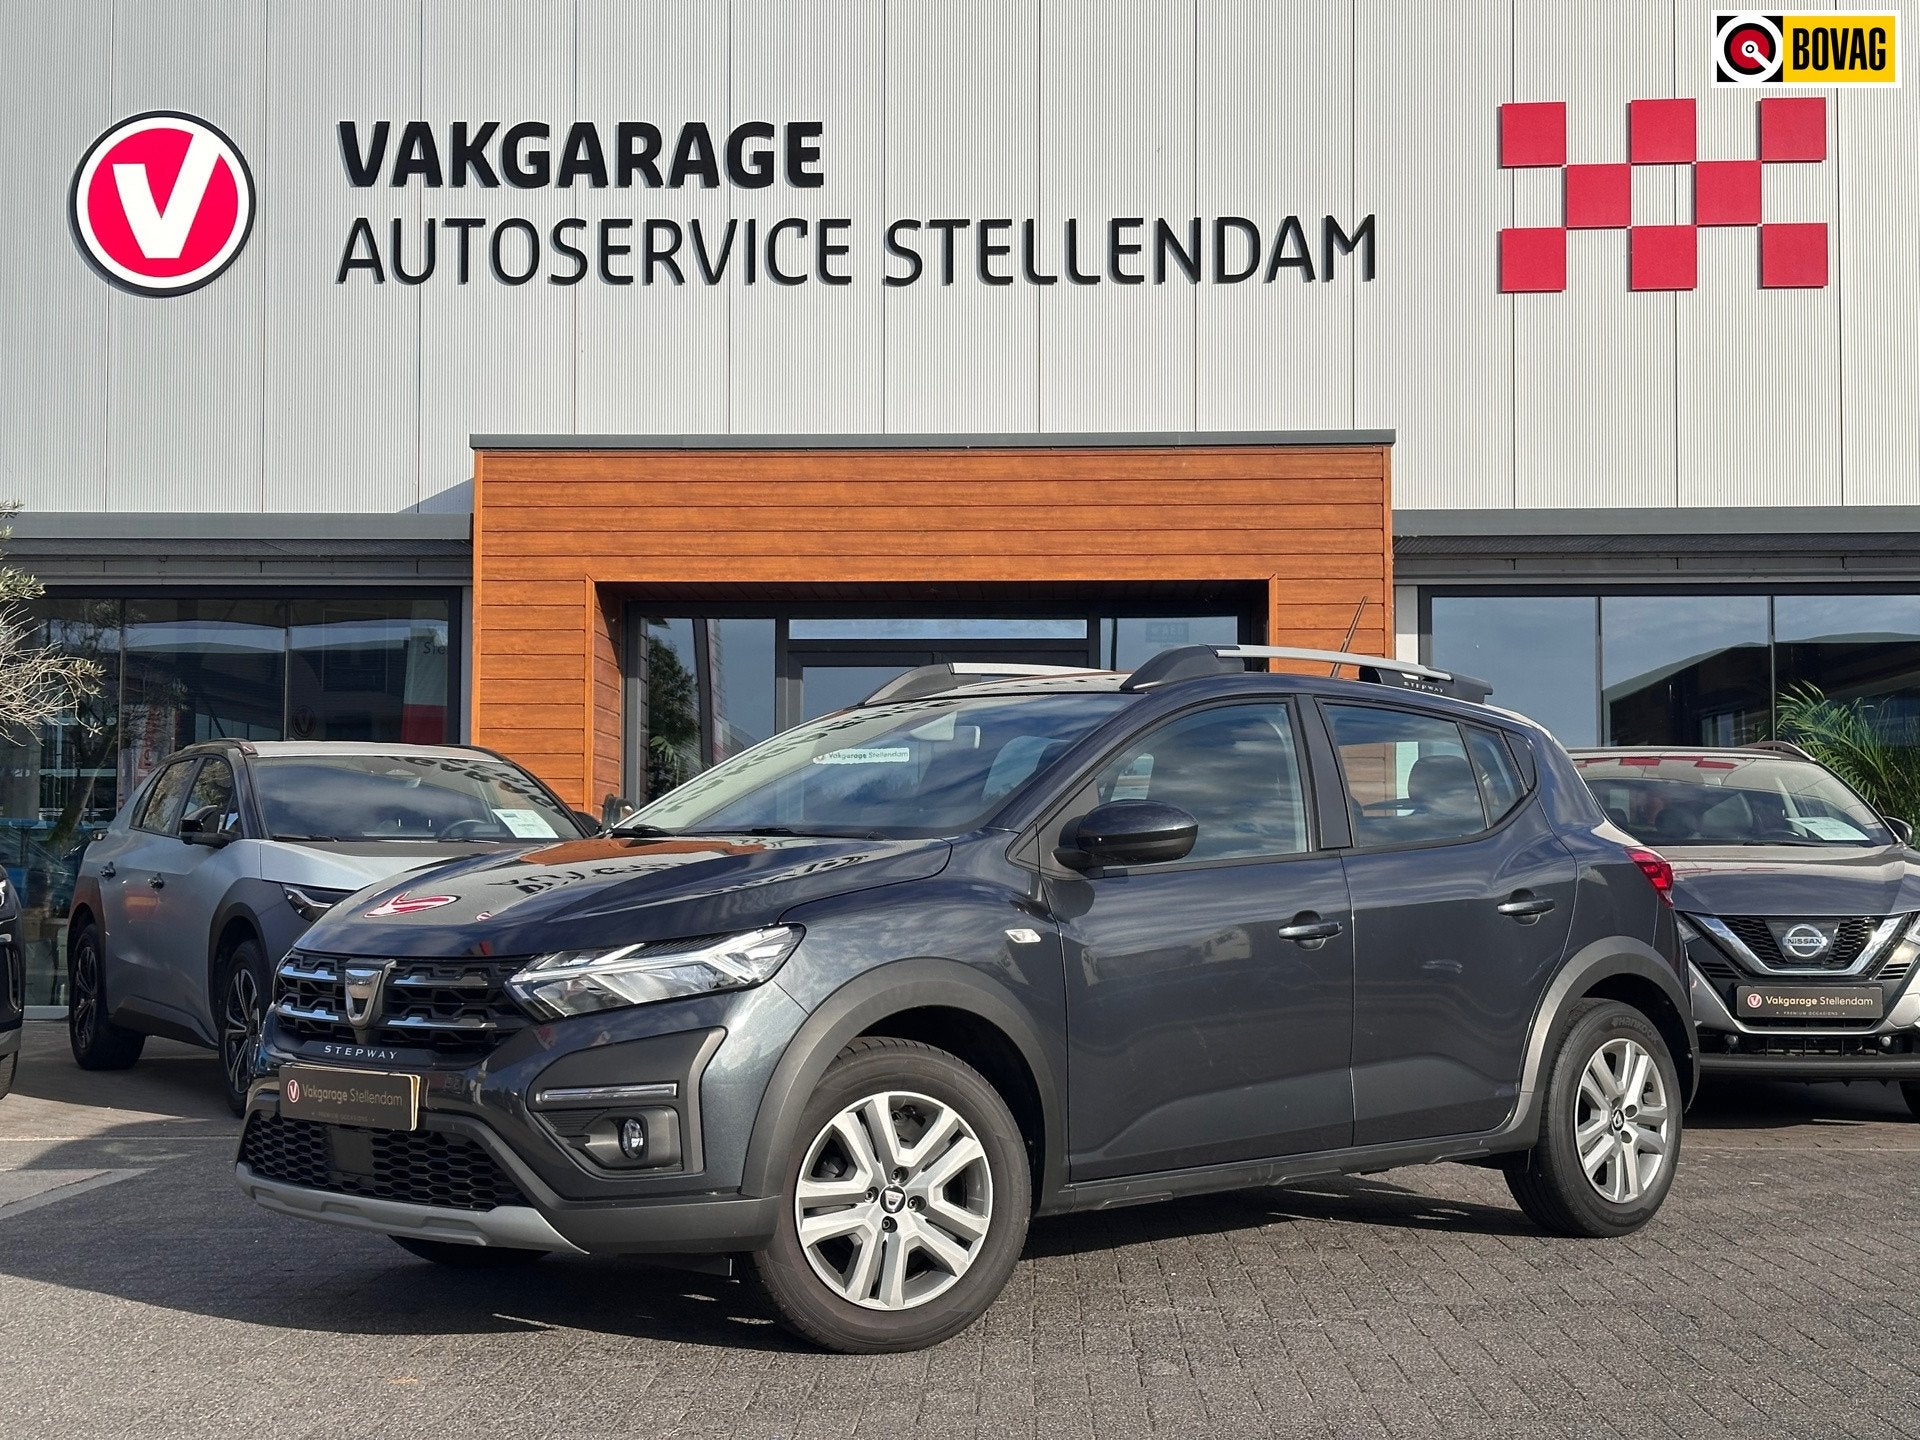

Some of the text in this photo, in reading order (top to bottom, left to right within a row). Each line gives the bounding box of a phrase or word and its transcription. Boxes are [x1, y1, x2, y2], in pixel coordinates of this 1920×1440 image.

[338, 120, 824, 188] VAKGARAGE
[338, 214, 1376, 286] AUTOSERVICE STELLENDAM
[1403, 681, 1443, 692] STEPWAY
[1765, 995, 1873, 1007] Vakgarage Stellendam
[324, 1045, 398, 1060] STEPWAY
[302, 1083, 403, 1107] Vakgarage Stellendam
